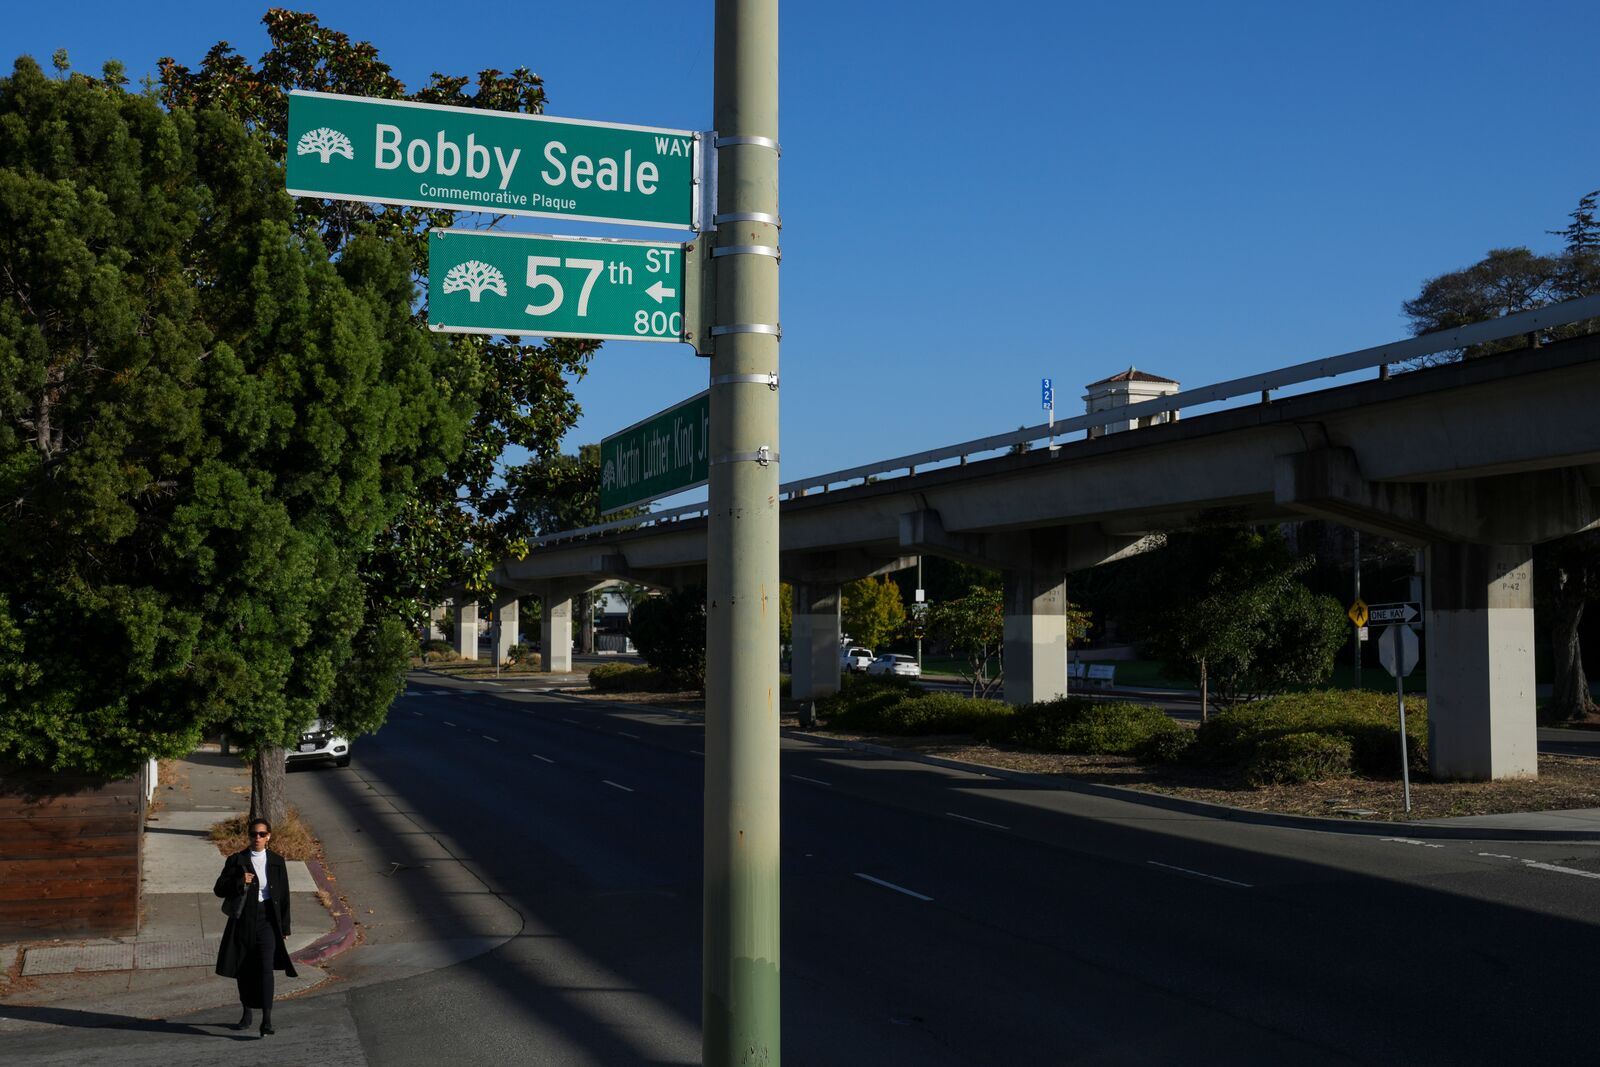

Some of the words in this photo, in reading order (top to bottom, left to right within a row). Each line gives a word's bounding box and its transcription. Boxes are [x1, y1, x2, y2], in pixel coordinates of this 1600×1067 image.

[375, 123, 521, 190] Bobby
[541, 140, 659, 195] Seale
[655, 136, 692, 157] WAY
[420, 183, 527, 205] Commemorative
[533, 193, 577, 210] Plaque
[645, 249, 675, 274] ST
[524, 255, 633, 317] 57th
[634, 310, 684, 336] 800
[1044, 379, 1050, 389] 3
[1044, 391, 1050, 400] 2
[616, 438, 640, 490] Martin
[643, 427, 670, 481] Luther
[674, 416, 694, 481] King
[1372, 610, 1387, 620] ONE
